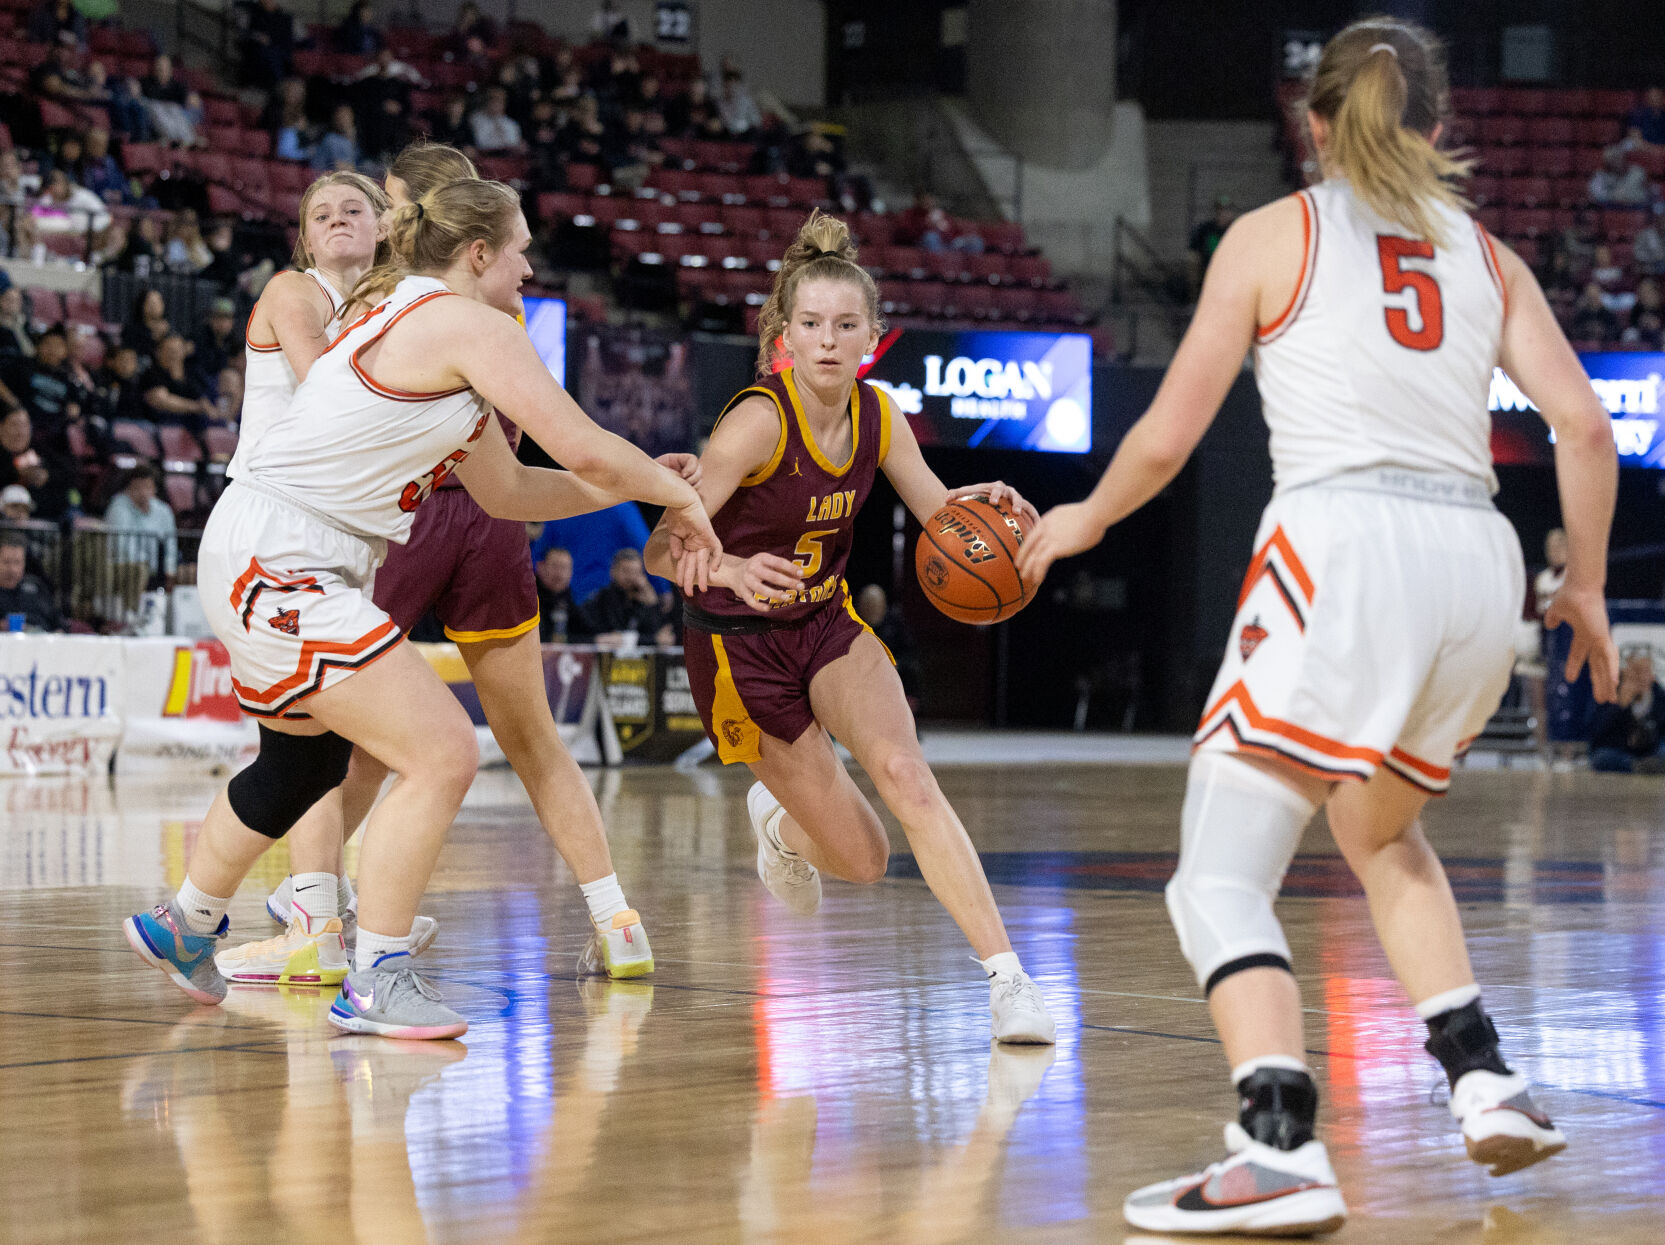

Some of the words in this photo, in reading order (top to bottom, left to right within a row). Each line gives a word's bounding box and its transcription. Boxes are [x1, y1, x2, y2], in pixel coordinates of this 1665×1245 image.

[1376, 233, 1445, 353] 5
[923, 355, 1053, 400] LOGAN
[806, 489, 856, 522] LADY
[792, 527, 840, 579] 5
